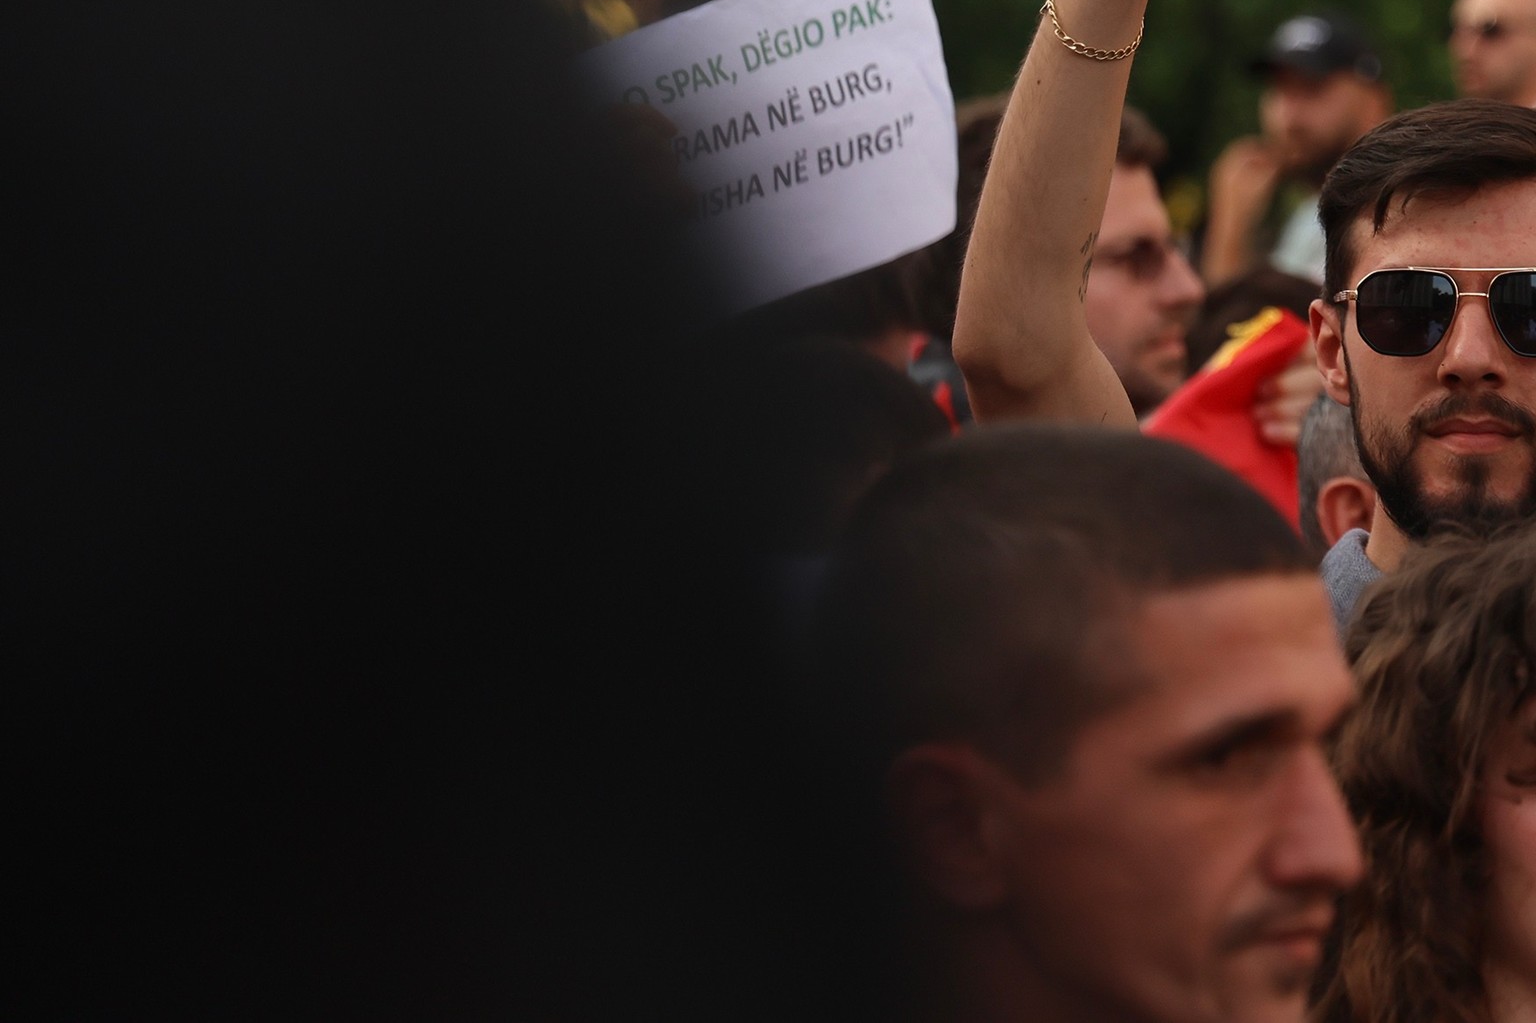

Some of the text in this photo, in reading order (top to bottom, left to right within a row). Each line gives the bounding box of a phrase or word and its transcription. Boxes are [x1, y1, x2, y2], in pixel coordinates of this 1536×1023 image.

[655, 54, 738, 105] SPAK,
[740, 18, 825, 73] DËGJO
[767, 89, 804, 131] NË
[809, 62, 893, 116] BURG,
[699, 173, 765, 220] ISHA
[773, 149, 809, 193] NË
